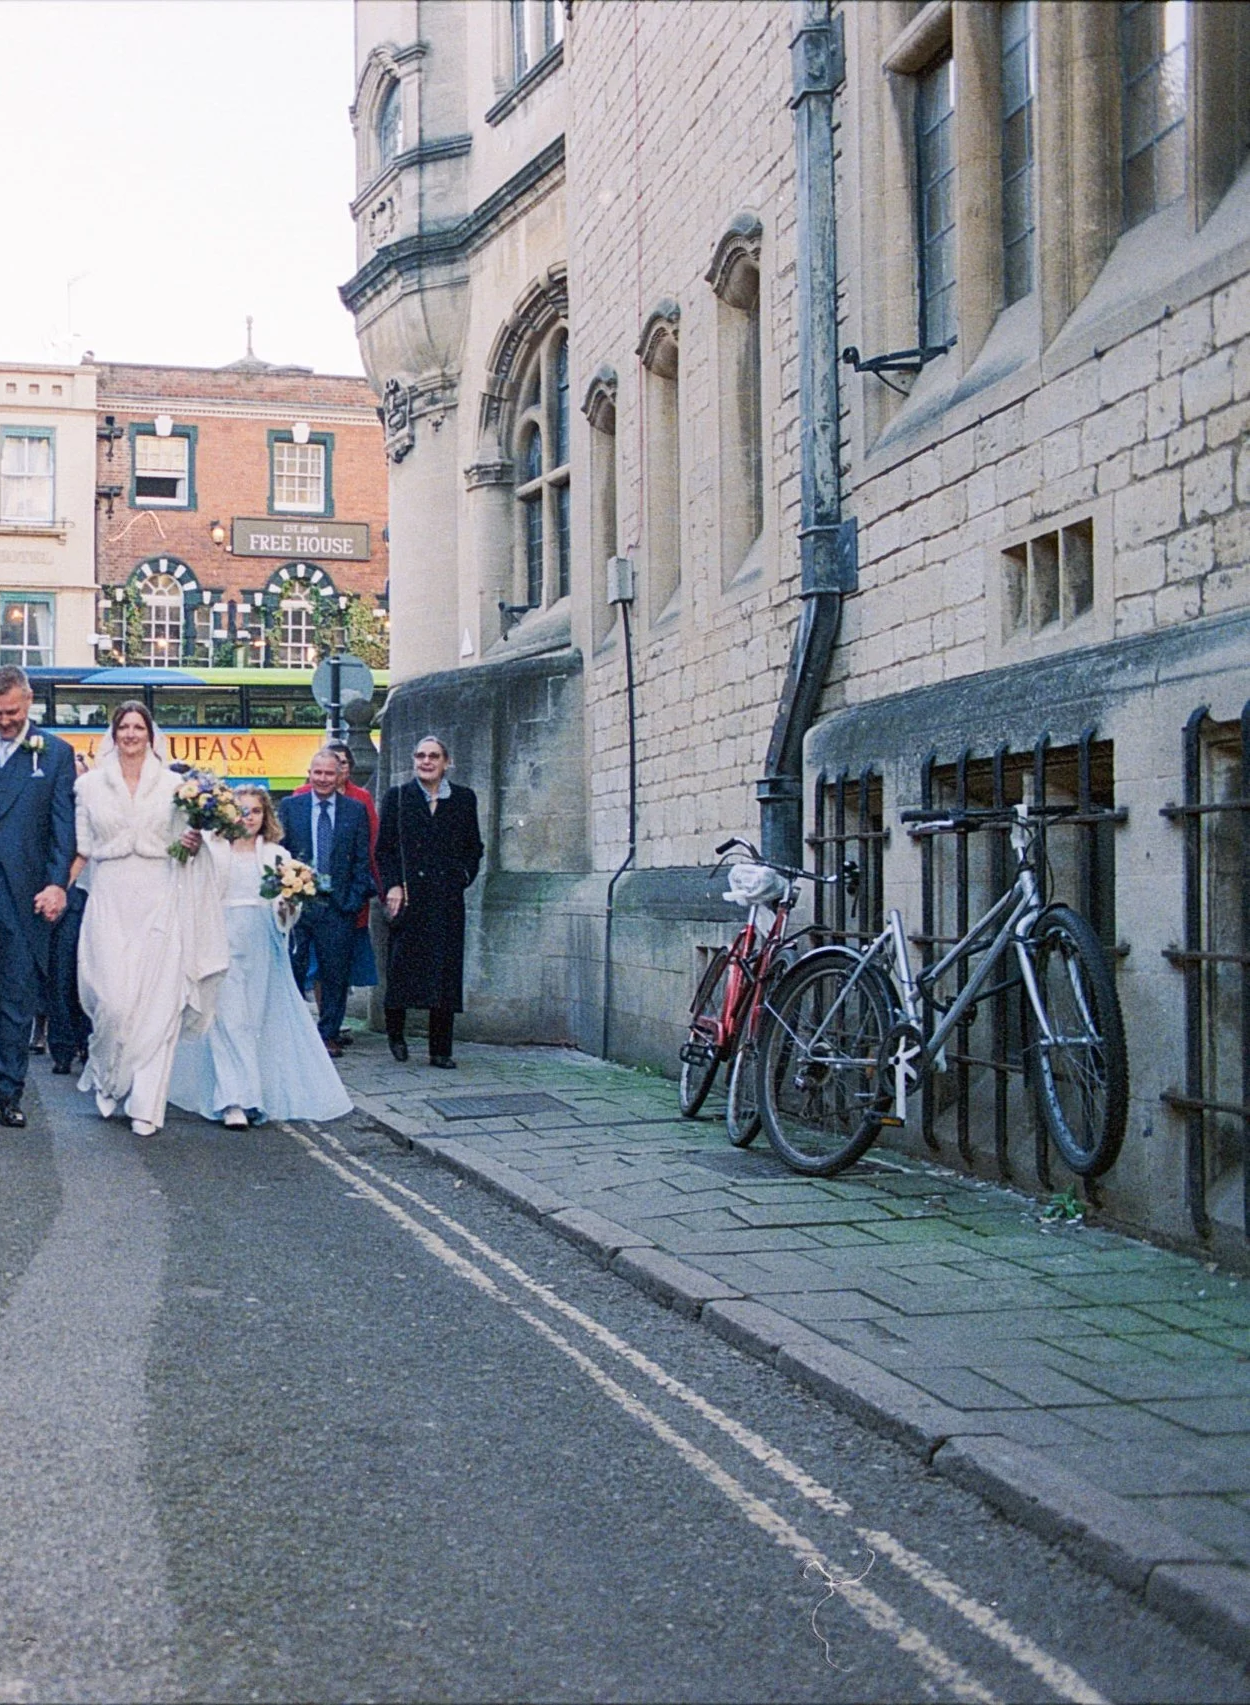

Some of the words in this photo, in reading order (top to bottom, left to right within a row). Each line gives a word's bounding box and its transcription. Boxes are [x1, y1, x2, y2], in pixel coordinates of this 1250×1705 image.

[249, 533, 292, 552] FREE
[296, 536, 354, 555] HOUSE
[169, 735, 264, 761] UFASA
[227, 764, 267, 776] KING
